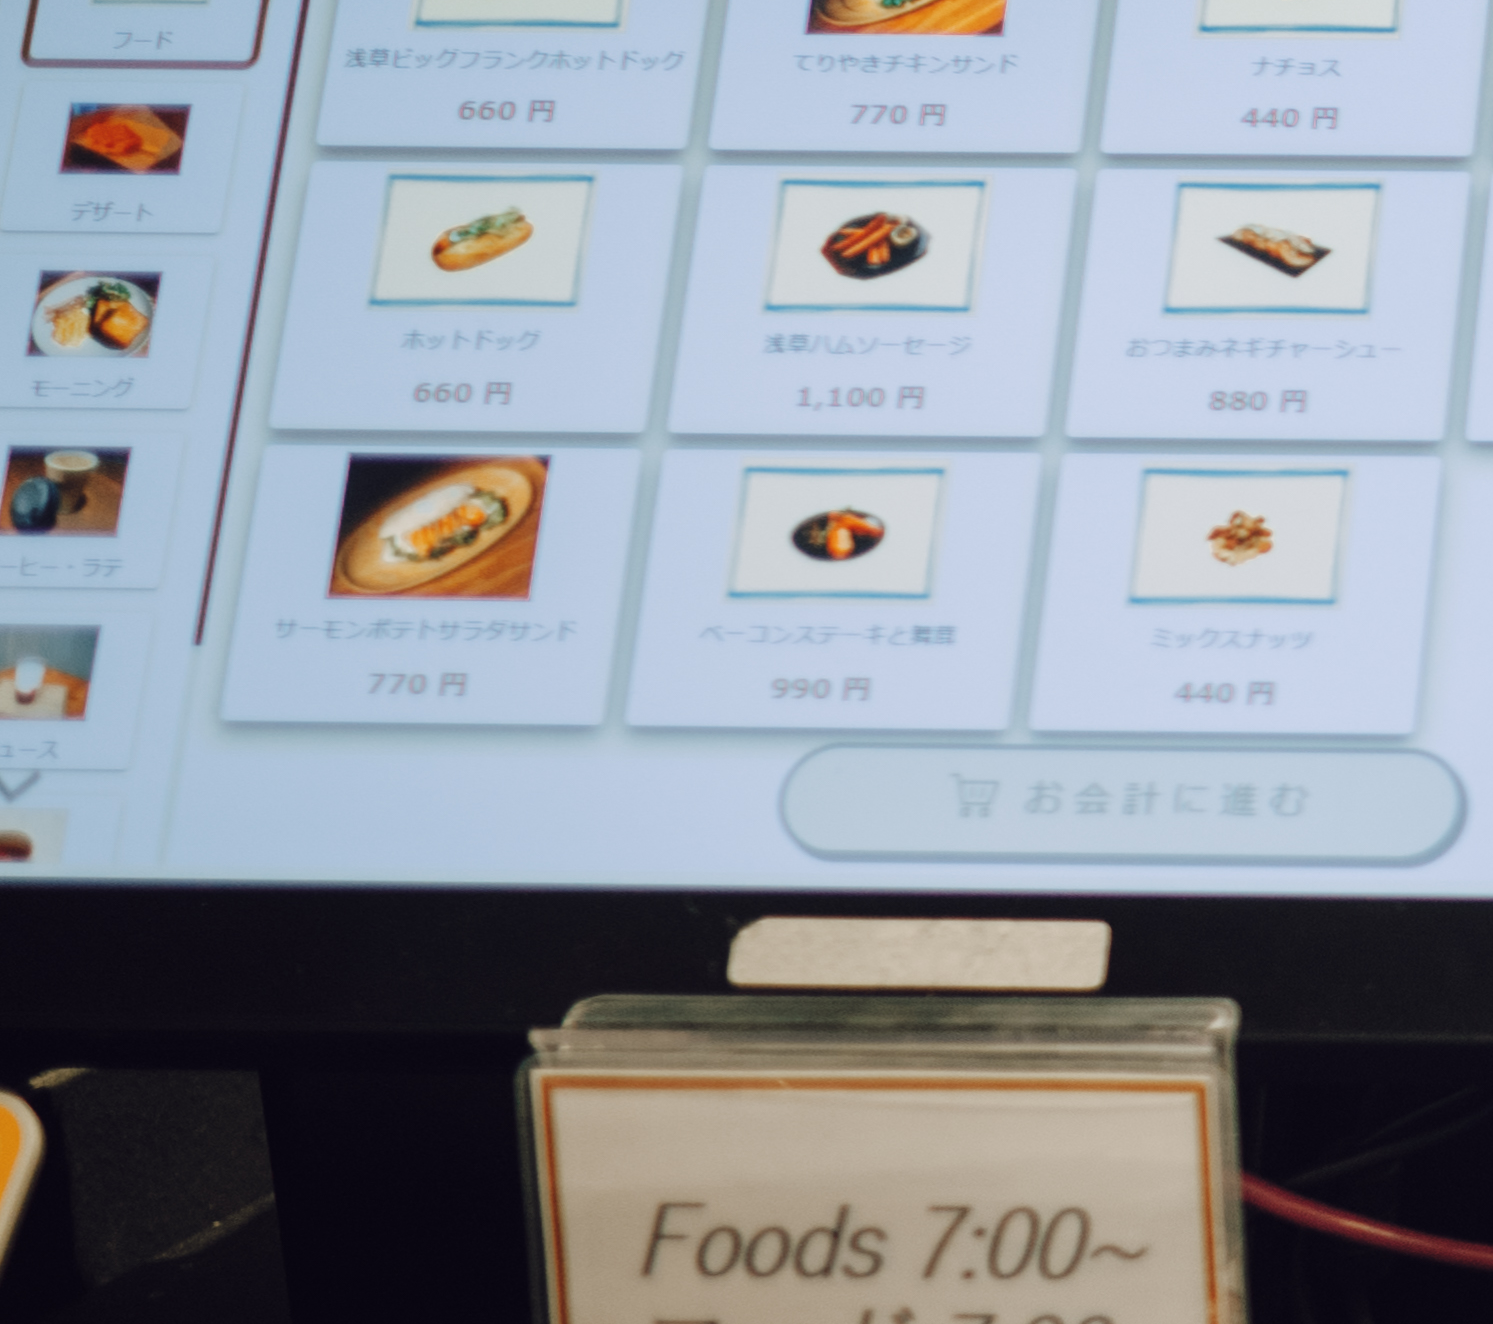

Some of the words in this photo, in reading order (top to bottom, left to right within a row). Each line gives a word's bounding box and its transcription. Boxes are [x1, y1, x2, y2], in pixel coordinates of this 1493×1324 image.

[113, 30, 173, 51] フード
[458, 100, 517, 122] 660
[527, 98, 556, 124] 円
[640, 1201, 885, 1279] Foods
